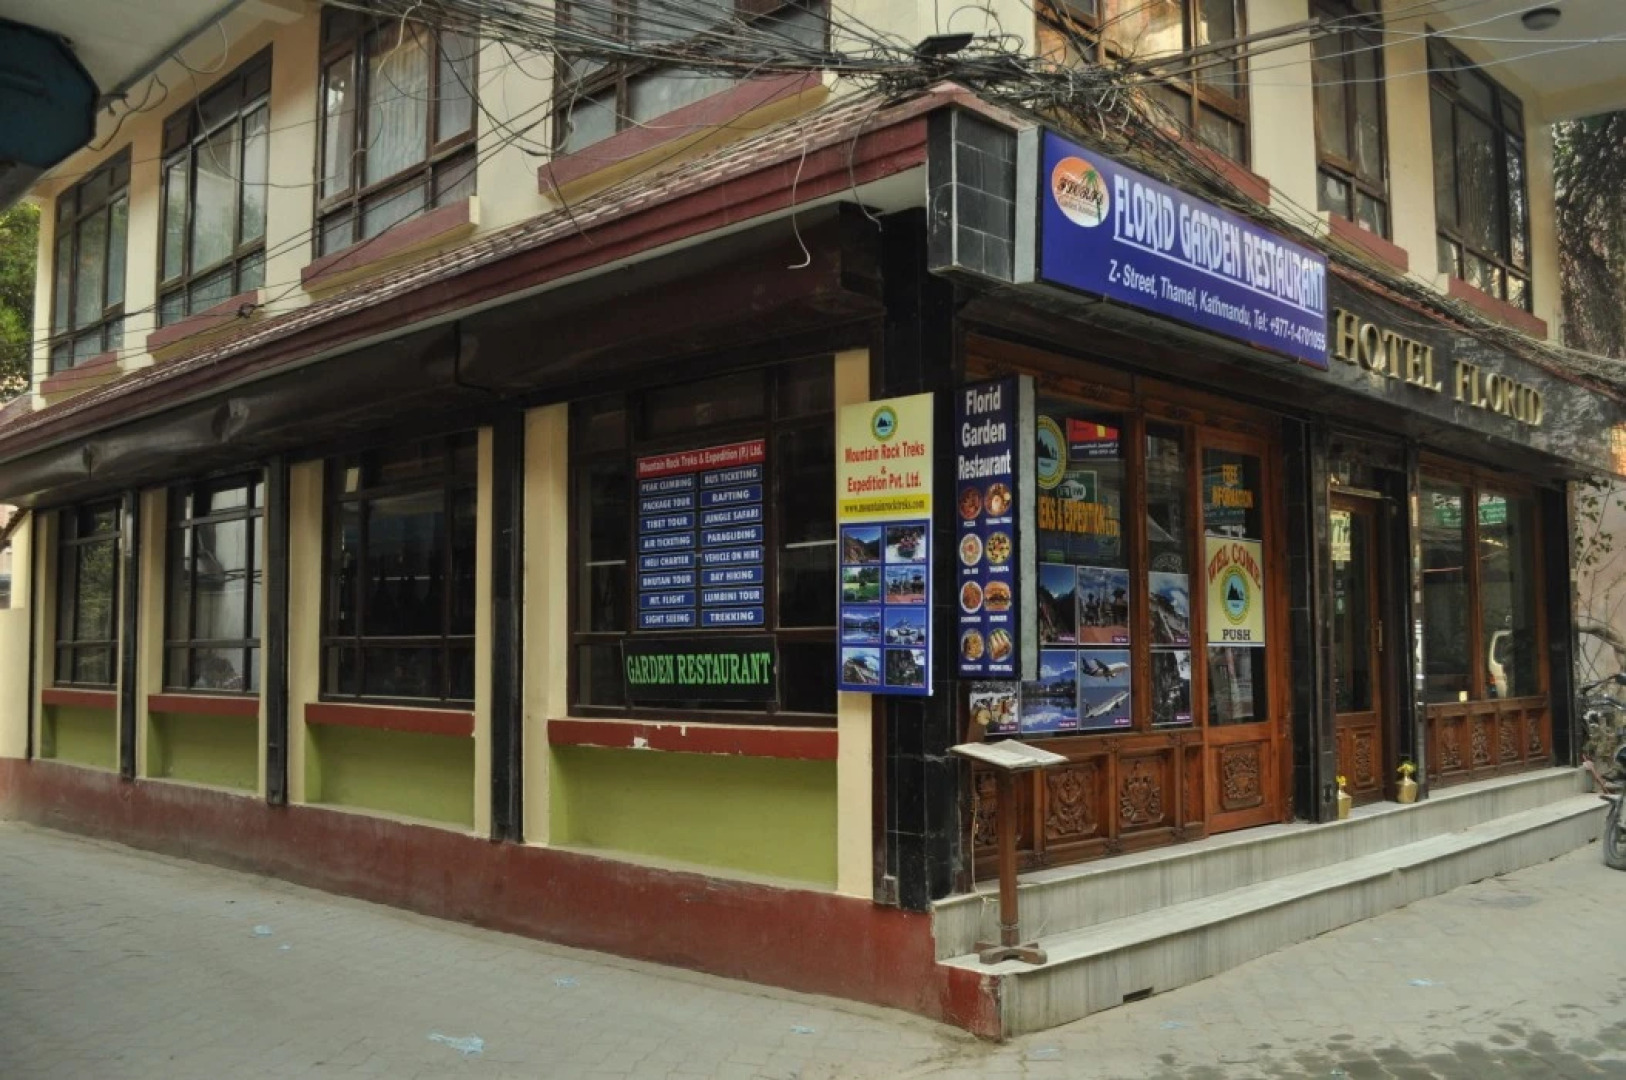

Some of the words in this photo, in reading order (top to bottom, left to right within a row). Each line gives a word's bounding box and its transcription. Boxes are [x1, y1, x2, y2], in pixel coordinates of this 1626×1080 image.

[1113, 174, 1175, 252] FLORID
[1180, 203, 1242, 279] GARDEN
[1243, 230, 1324, 311] RESTAURANT
[1123, 264, 1157, 299] Street,
[1160, 276, 1197, 312] Thamel,
[1200, 290, 1251, 331] Kathmandu,
[1332, 307, 1442, 393] HOTEL
[1453, 359, 1543, 426] FLORID
[966, 384, 1002, 416] Florid
[962, 418, 1007, 448] Garden
[845, 446, 879, 463] Mountain
[881, 443, 900, 459] Rock
[902, 441, 925, 457] Treks
[958, 448, 1012, 480] Restaurant
[720, 469, 757, 482] TICKETING
[1222, 463, 1239, 484] FREE
[660, 478, 692, 490] CLIMBING
[847, 475, 887, 495] Expedition
[889, 472, 904, 489] Pvt.
[906, 471, 922, 488] Ltd.
[712, 490, 749, 503] RAFTING
[643, 500, 671, 511] PACKAGE
[673, 497, 690, 507] TOUR
[646, 518, 665, 529] TIBET
[668, 516, 688, 527] TOUR
[705, 511, 731, 524] JUNGLE
[733, 508, 758, 520] SAFARI
[644, 539, 655, 549] AIR
[656, 536, 690, 547] TICKETING
[707, 528, 756, 543] PARAGLIDING
[660, 555, 689, 566] CHARTER
[705, 551, 730, 563] VEHICLE
[731, 551, 741, 561] ON
[743, 549, 759, 560] HIRE
[642, 576, 671, 587] BHUTAN
[672, 575, 691, 585] TOUR
[710, 572, 724, 582] DAY
[726, 570, 753, 581] HIKING
[662, 594, 685, 604] FLIGHT
[704, 591, 737, 602] LUMBINI
[739, 590, 760, 600] TOUR
[645, 615, 664, 624] SIGHT
[710, 611, 754, 622] TREKKING
[1222, 628, 1251, 641] PUSH
[627, 654, 674, 684] GARDEN
[676, 652, 770, 684] RESTAURANT
